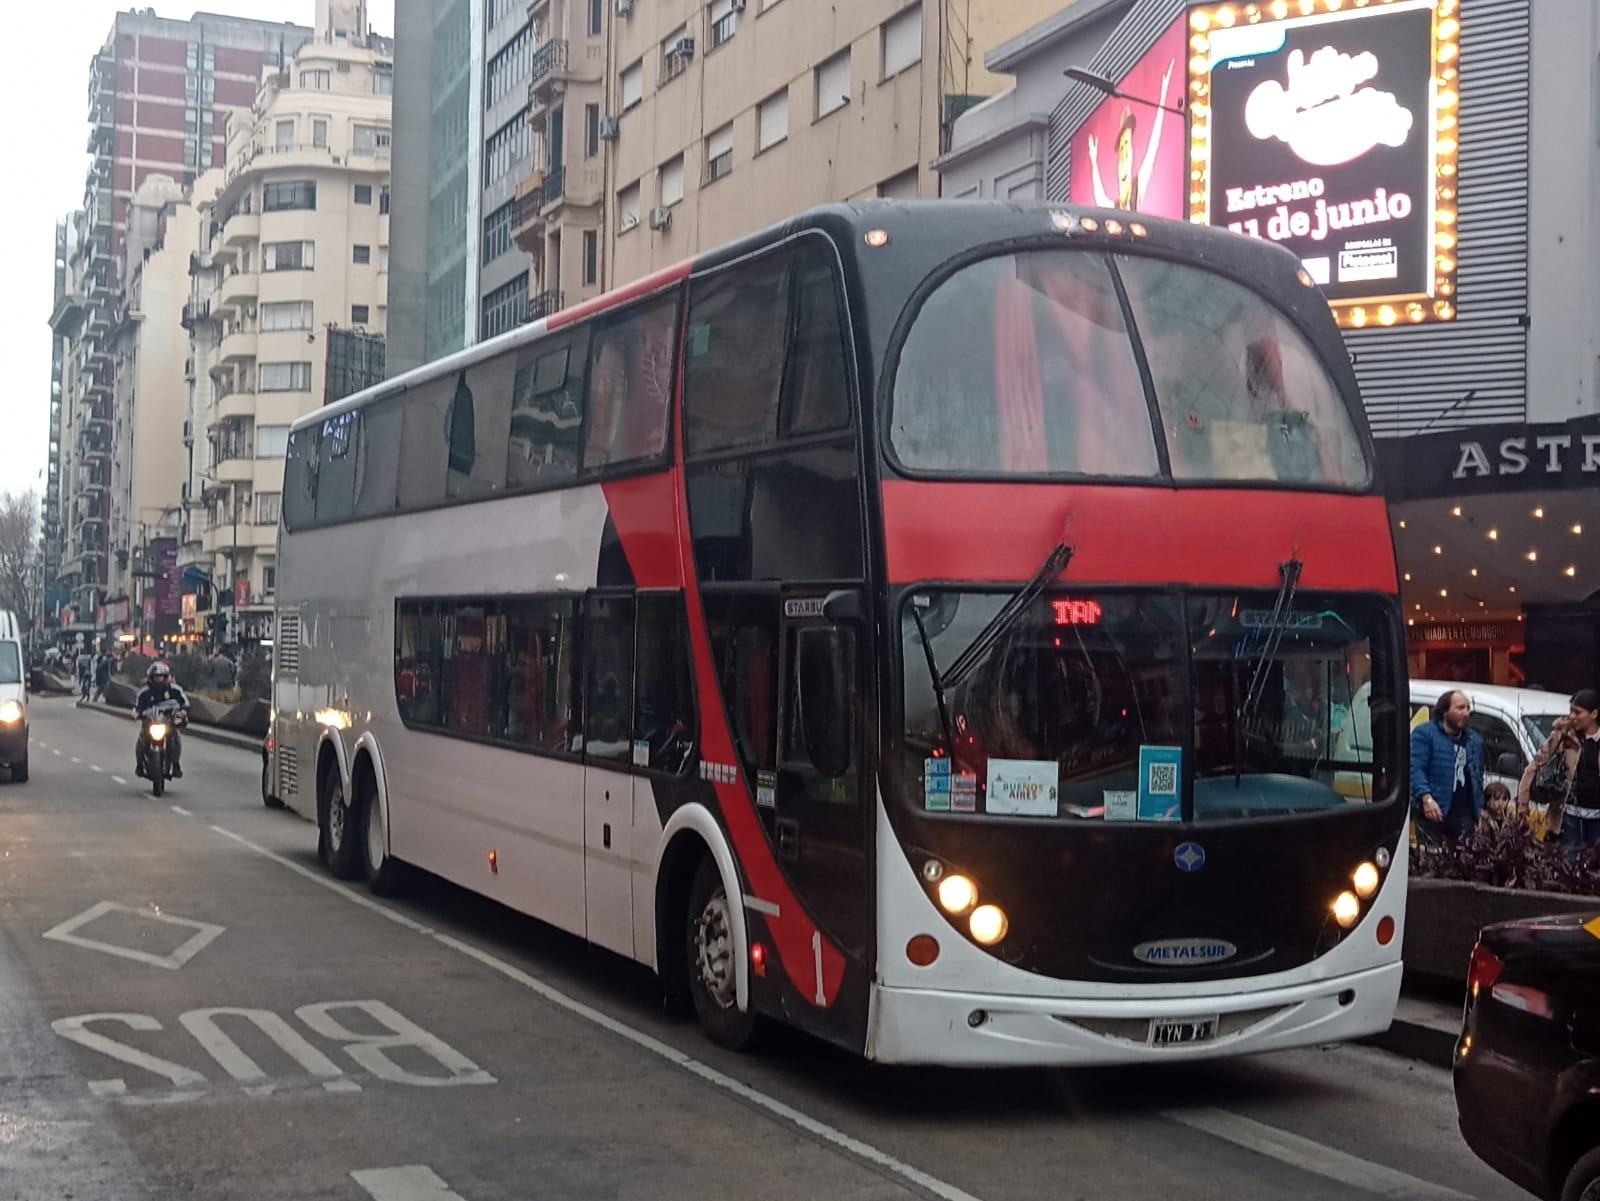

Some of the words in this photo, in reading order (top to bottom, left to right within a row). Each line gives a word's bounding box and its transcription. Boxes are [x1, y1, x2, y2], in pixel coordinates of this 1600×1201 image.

[1226, 176, 1325, 213] Estreno
[1268, 205, 1310, 241] de
[1312, 189, 1412, 239] junio
[787, 601, 823, 614] STARBU
[1002, 782, 1044, 792] BUENOS
[1009, 791, 1038, 800] AIRES
[1145, 944, 1226, 959] METALSUR
[51, 999, 498, 1106] BUS
